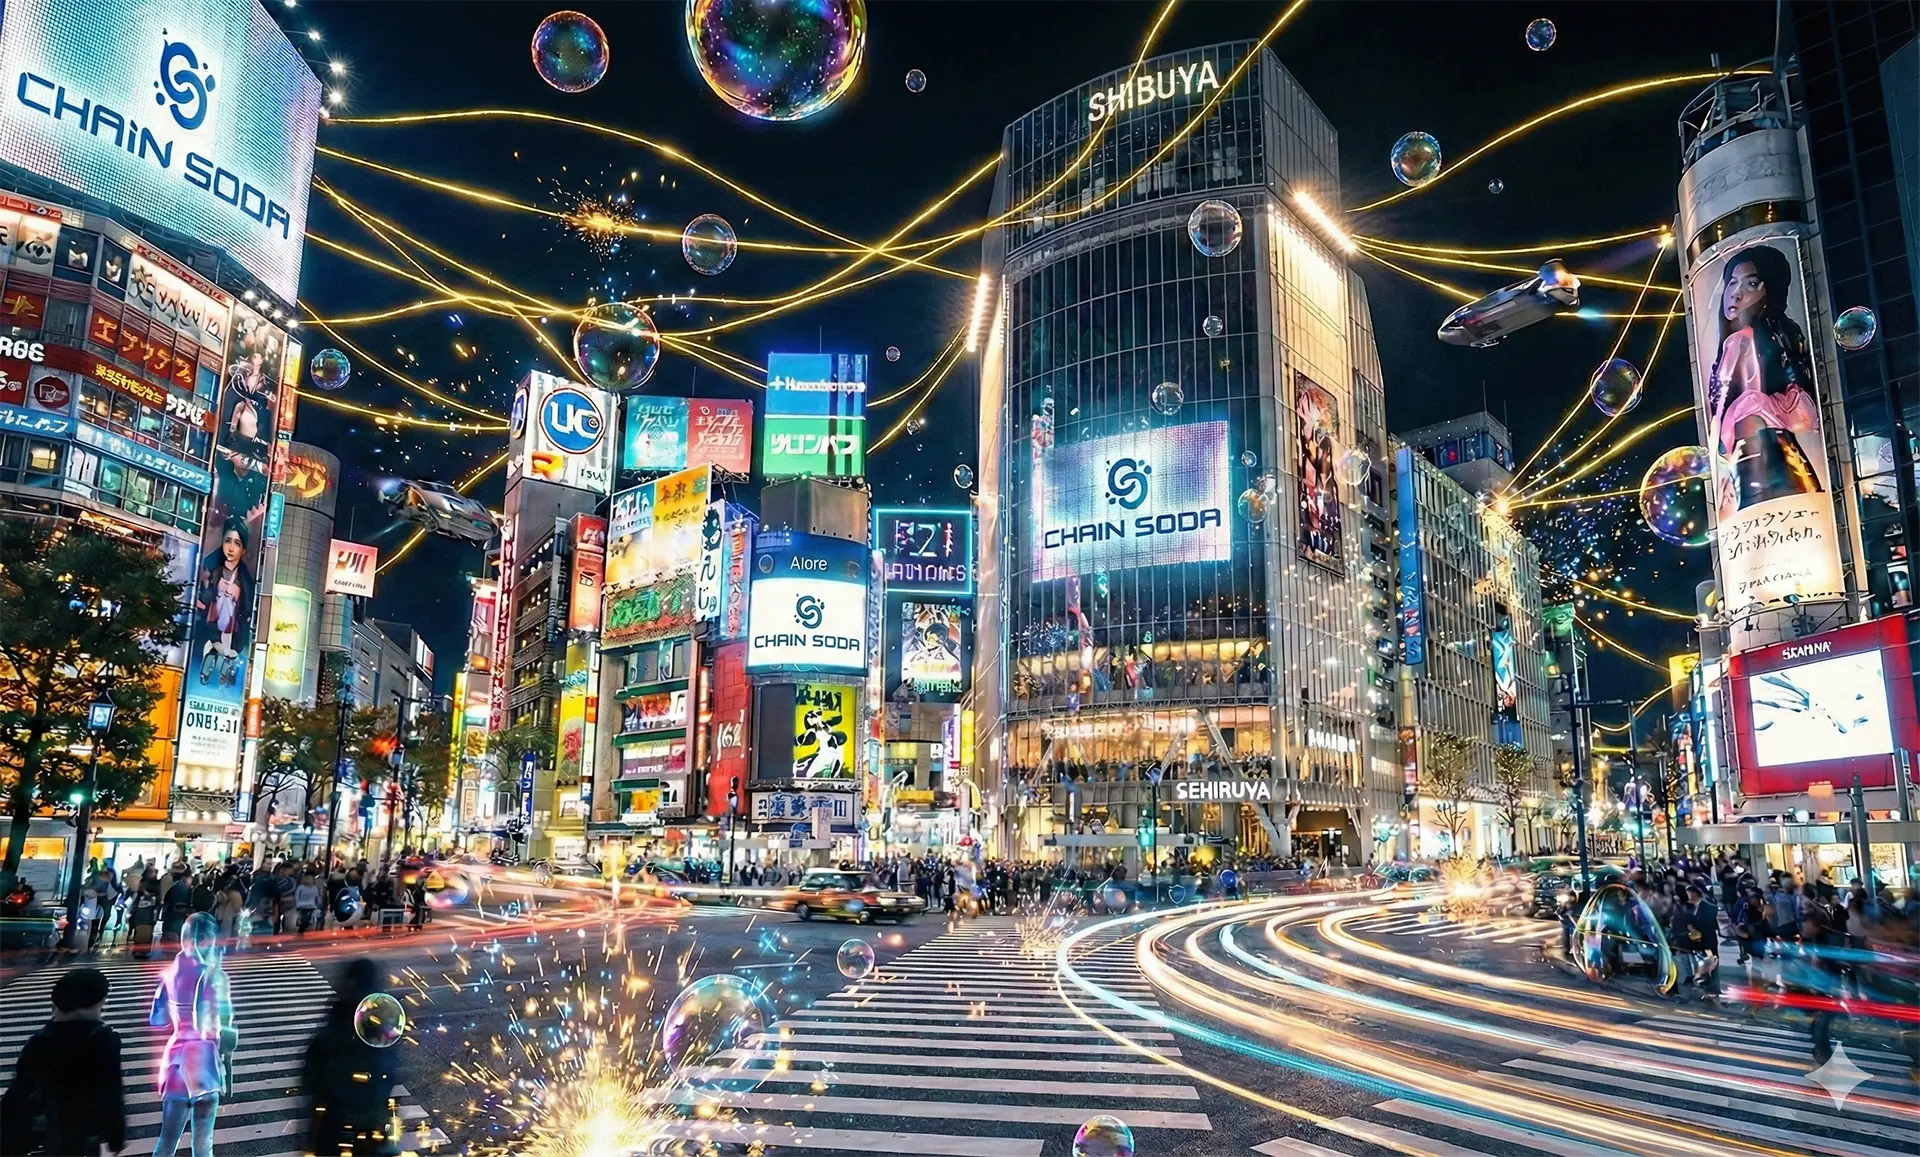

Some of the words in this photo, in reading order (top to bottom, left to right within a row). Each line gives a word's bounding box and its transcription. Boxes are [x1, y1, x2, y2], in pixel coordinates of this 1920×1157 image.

[1087, 59, 1221, 123] SHIBUYA
[184, 150, 291, 240] SODA
[1044, 520, 1126, 550] CHAIN
[1135, 507, 1222, 537] SODA
[790, 555, 828, 571] Alore
[754, 634, 807, 649] CHAIN
[812, 634, 860, 651] SODA
[1176, 781, 1271, 801] SEHIRUYA
